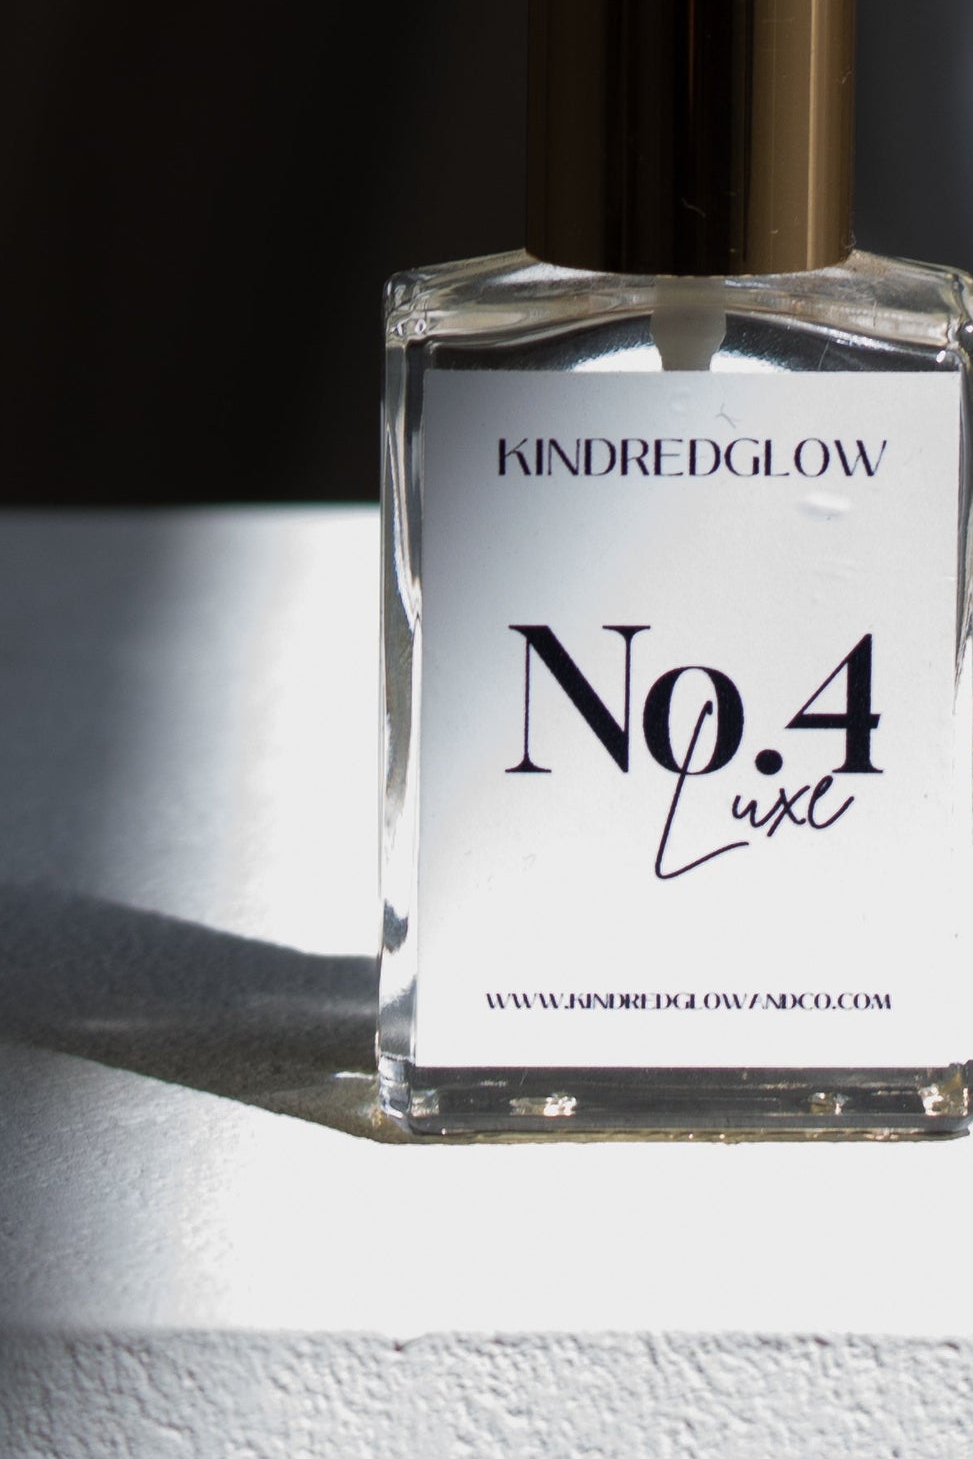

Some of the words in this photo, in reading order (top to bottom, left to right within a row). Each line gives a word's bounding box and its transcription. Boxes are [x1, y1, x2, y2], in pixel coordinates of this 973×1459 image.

[498, 437, 888, 478] KINDREDGLOW
[505, 625, 883, 775] No.4
[655, 700, 855, 879] Luxe
[485, 992, 892, 1010] WWW.KINDREDGLOWANDCO.COM
